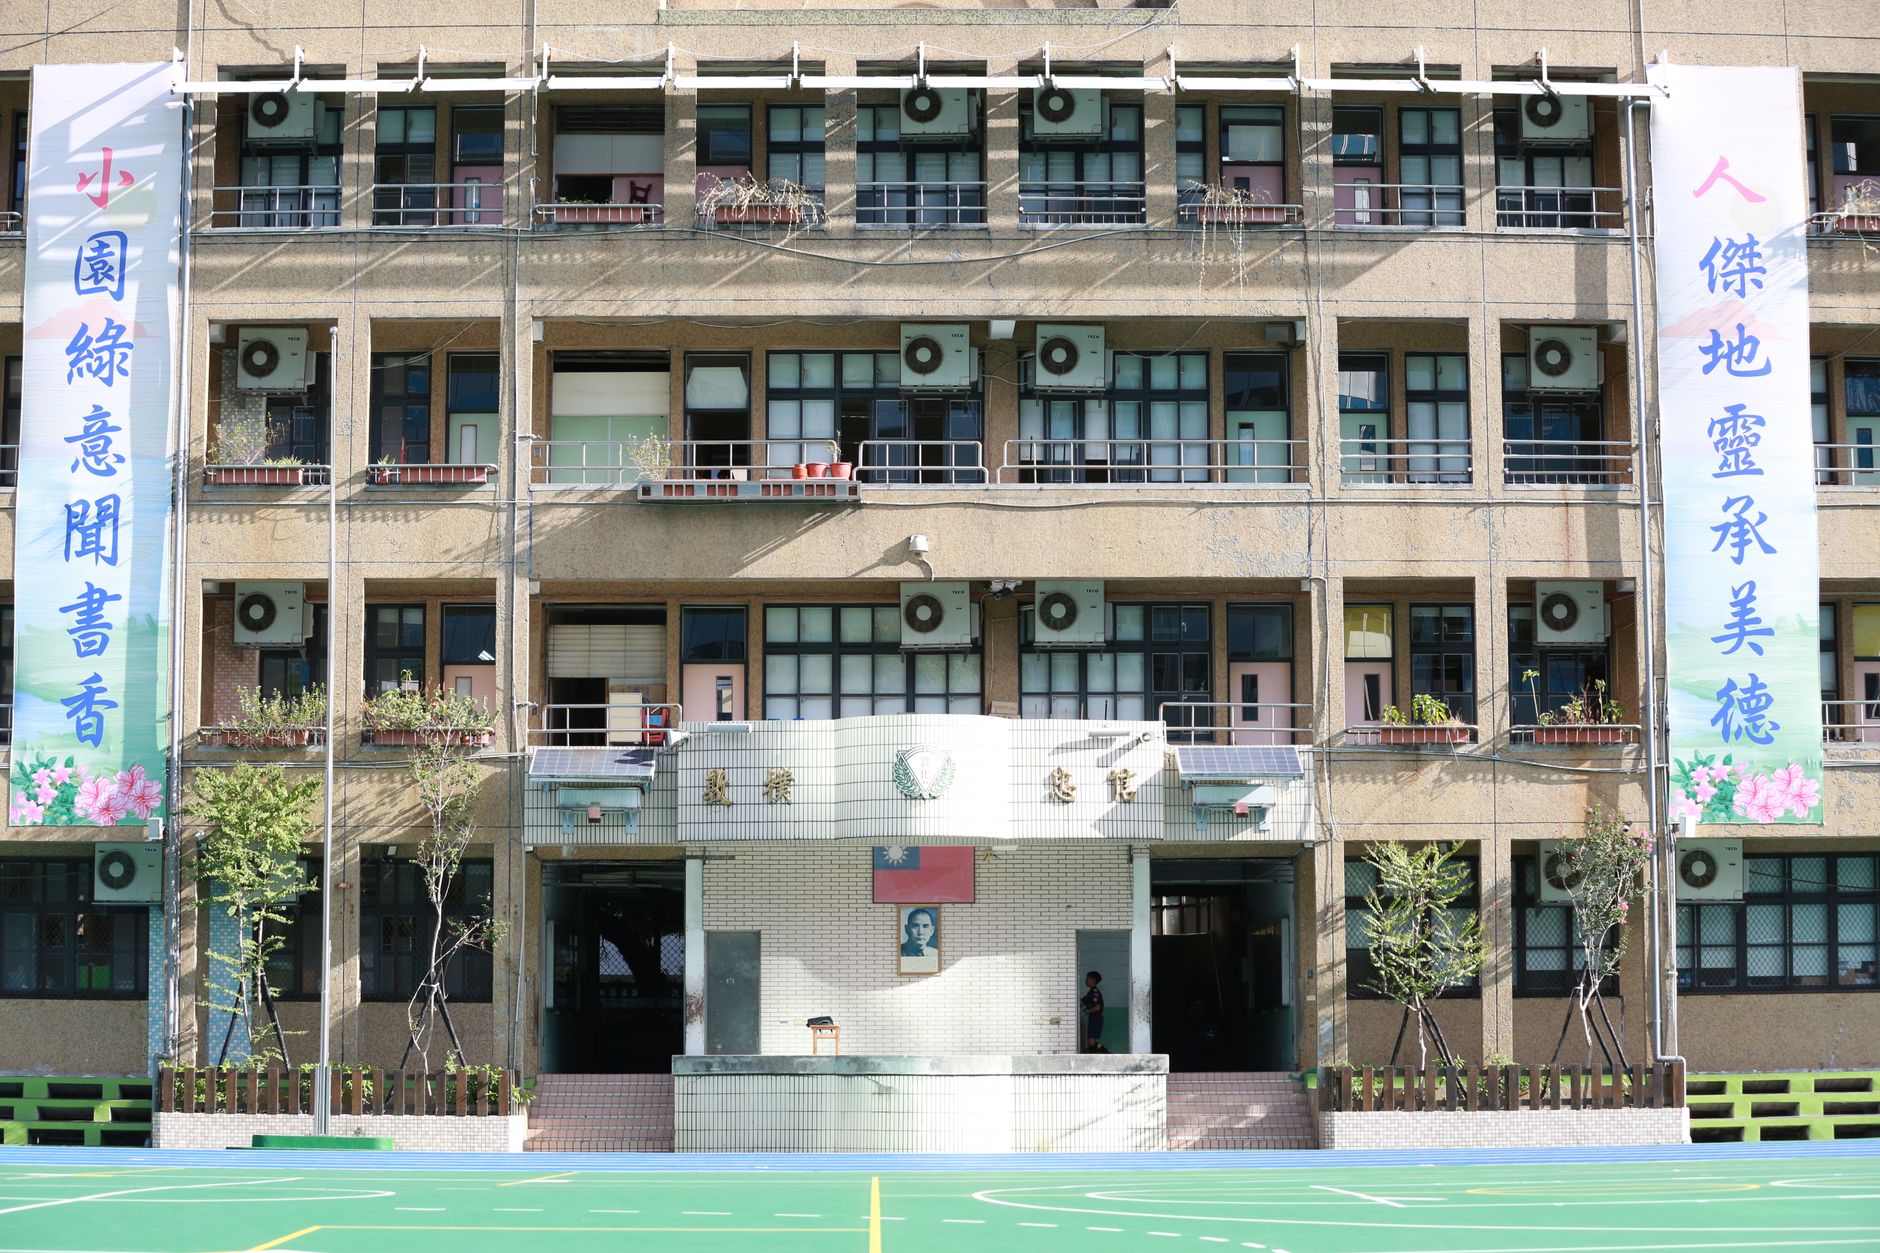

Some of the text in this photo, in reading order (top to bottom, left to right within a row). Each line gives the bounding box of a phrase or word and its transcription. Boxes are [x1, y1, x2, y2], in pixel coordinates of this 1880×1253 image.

[60, 147, 135, 748] 小園綠意聞書香
[1692, 154, 1781, 745] 人傑地靈承美德
